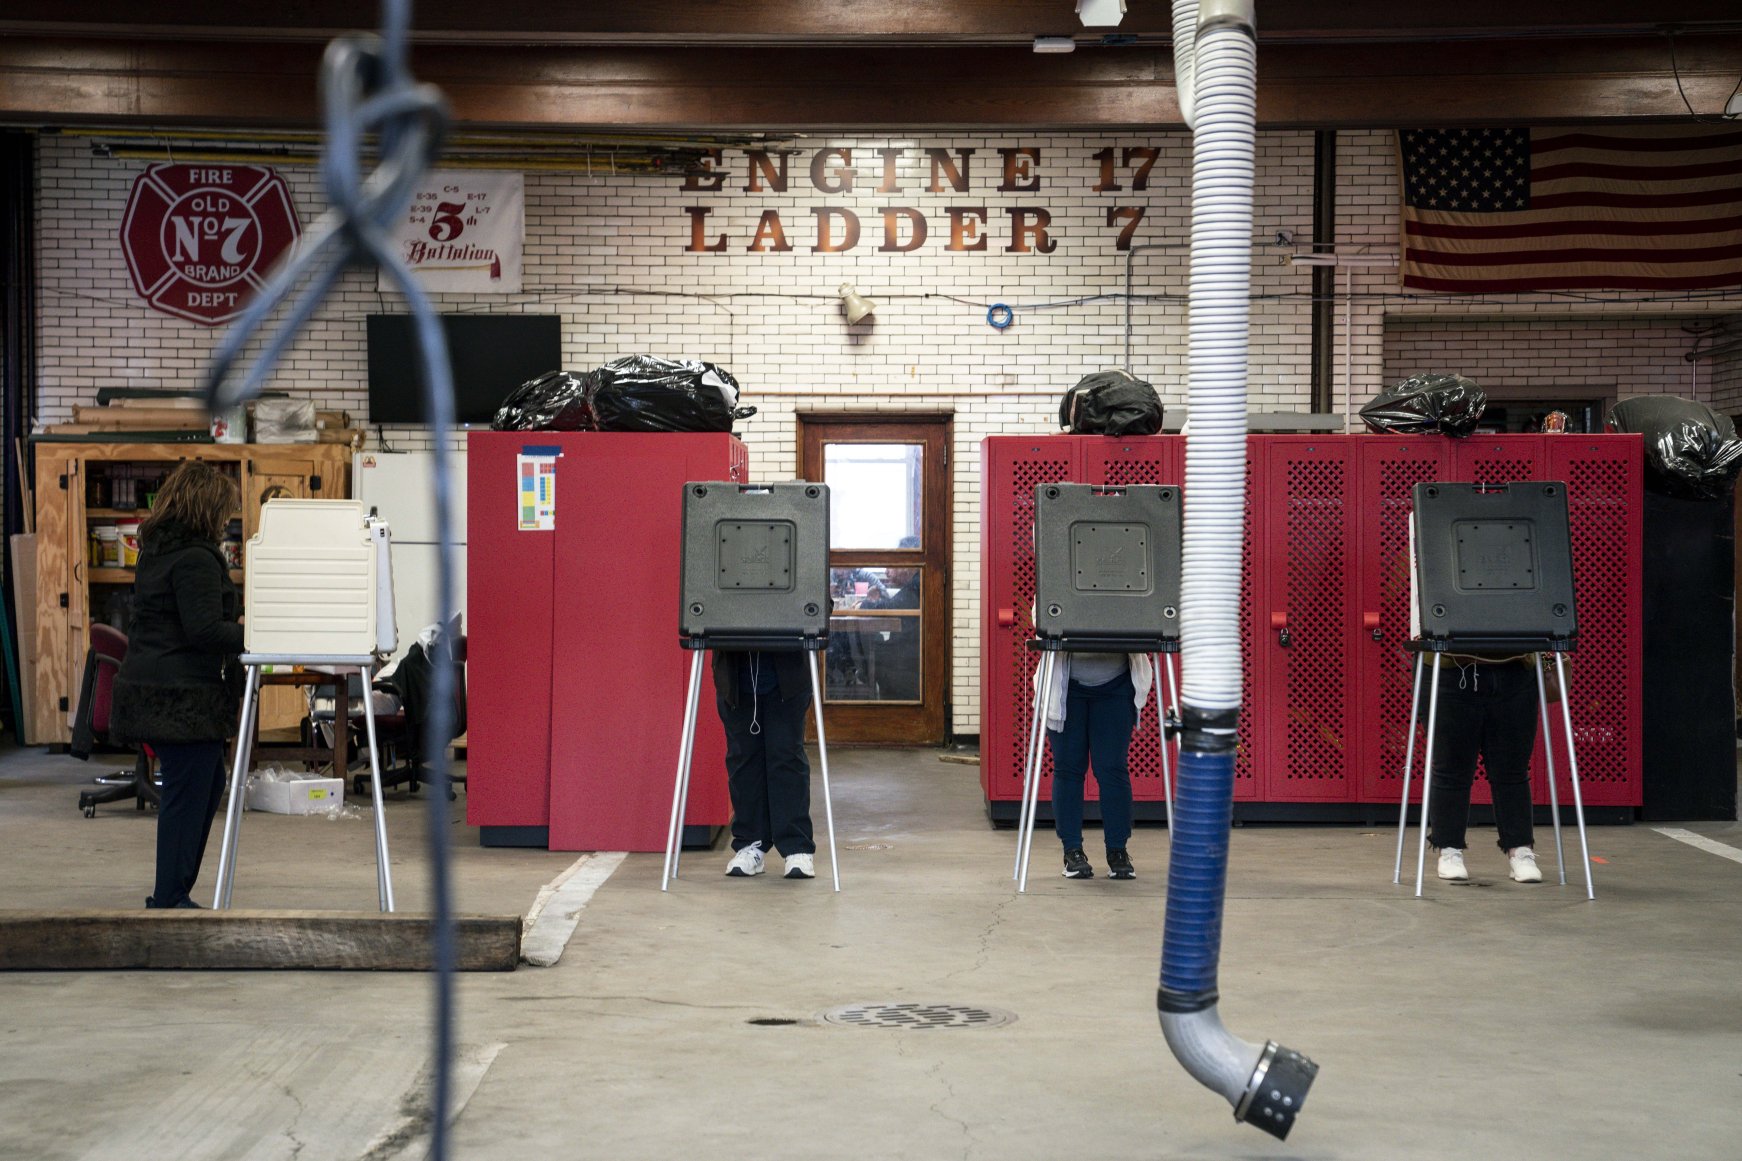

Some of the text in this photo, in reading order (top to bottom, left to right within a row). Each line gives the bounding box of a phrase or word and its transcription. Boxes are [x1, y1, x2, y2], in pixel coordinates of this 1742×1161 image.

[189, 169, 233, 184] FIRE
[679, 147, 1162, 194] ENGINE 17
[443, 185, 460, 193] C-5
[467, 193, 487, 201] E-17
[191, 195, 230, 212] OLD
[428, 201, 467, 242] 5
[684, 206, 1146, 254] LADDER 7
[184, 264, 240, 282] BRAND
[187, 292, 238, 308] DEPT
